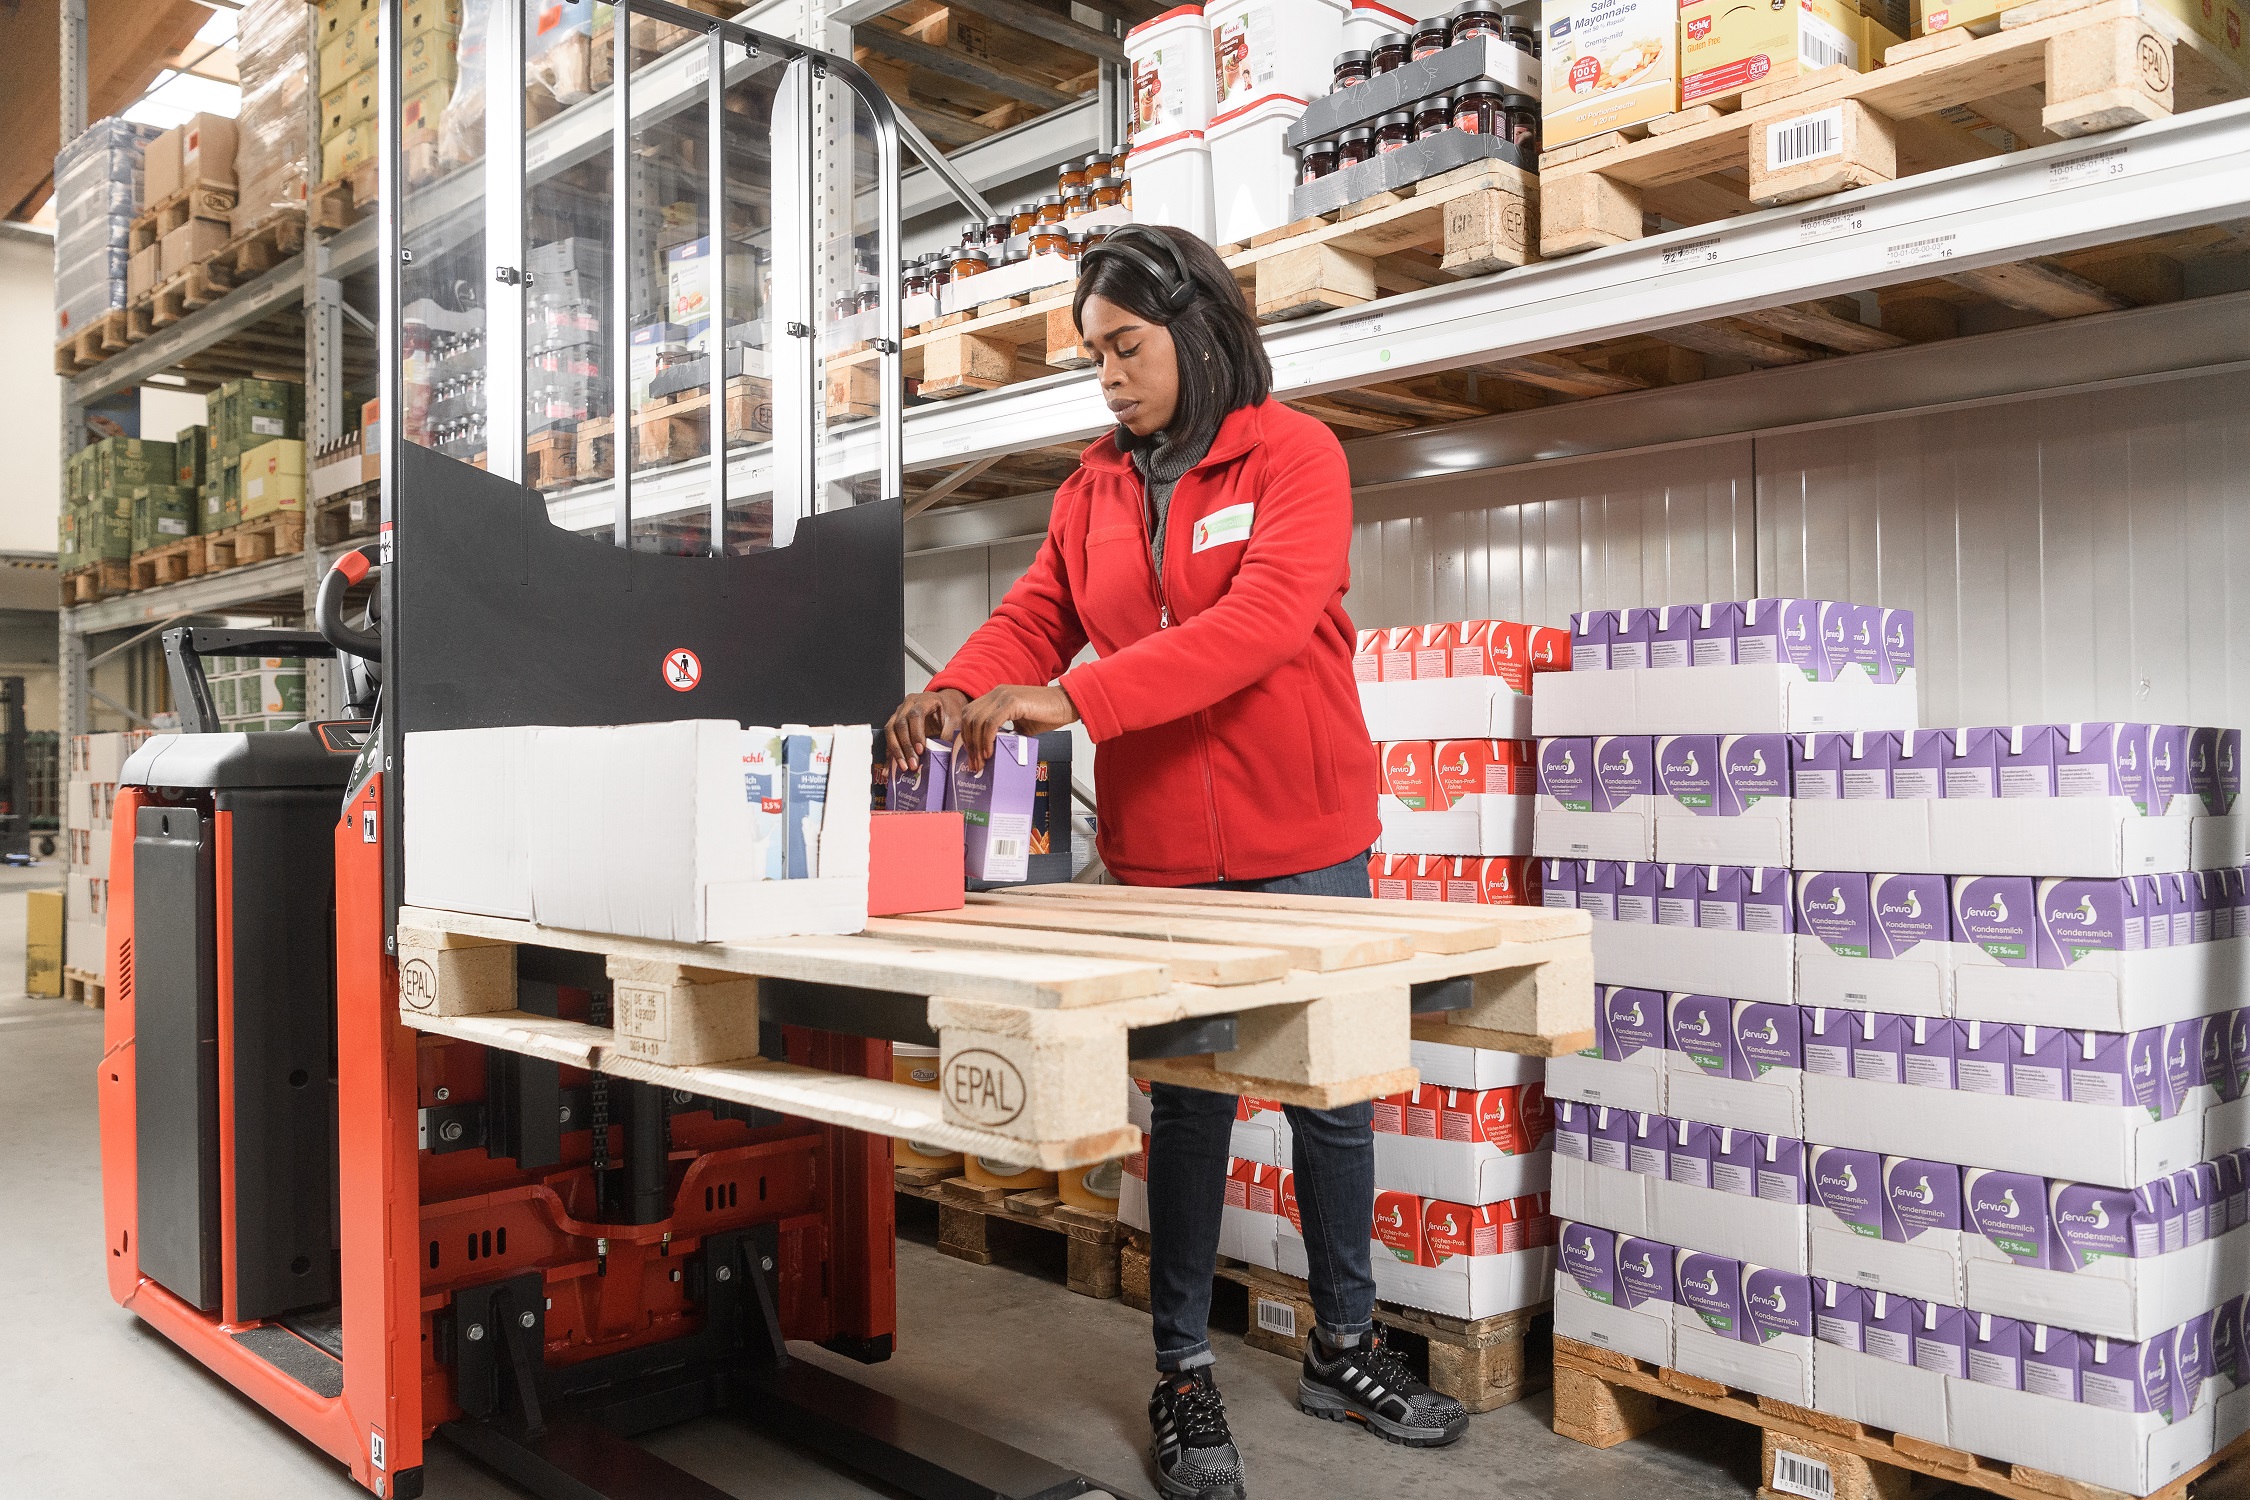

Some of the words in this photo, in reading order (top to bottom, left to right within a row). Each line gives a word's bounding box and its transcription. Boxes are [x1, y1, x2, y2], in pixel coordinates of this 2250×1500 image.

[1575, 3, 1637, 30] Mayonnaise
[1688, 18, 1711, 32] Schär
[1585, 30, 1624, 48] Cremig-mild
[1687, 41, 1706, 54] Gluten
[1707, 36, 1721, 47] Free
[1749, 64, 1769, 76] CLUB
[2141, 43, 2166, 84] EPAL
[1573, 69, 1589, 79] 100
[1591, 65, 1597, 74] €
[1576, 112, 1587, 123] 100
[1588, 100, 1637, 119] Portionsbeutel
[2110, 163, 2124, 174] 33
[1851, 220, 1862, 229] 18
[1707, 252, 1718, 261] 36
[1941, 249, 1952, 257] 16
[760, 408, 772, 423] EP
[801, 775, 826, 783] H-Vollm
[1971, 925, 2023, 935] Kondensmilch
[2057, 928, 2113, 938] Kondensmilch
[406, 969, 432, 999] EPAL
[955, 1063, 1014, 1112] EPAL
[1824, 1192, 1869, 1205] Kondensmilch
[1897, 1204, 1945, 1218] Kondensmilch
[1982, 1218, 2035, 1233] Kondensmilch
[1430, 1236, 1467, 1247] Küchen-Profi-
[2067, 1230, 2126, 1243] Kondensmilch
[1434, 1242, 1450, 1250] Sahne
